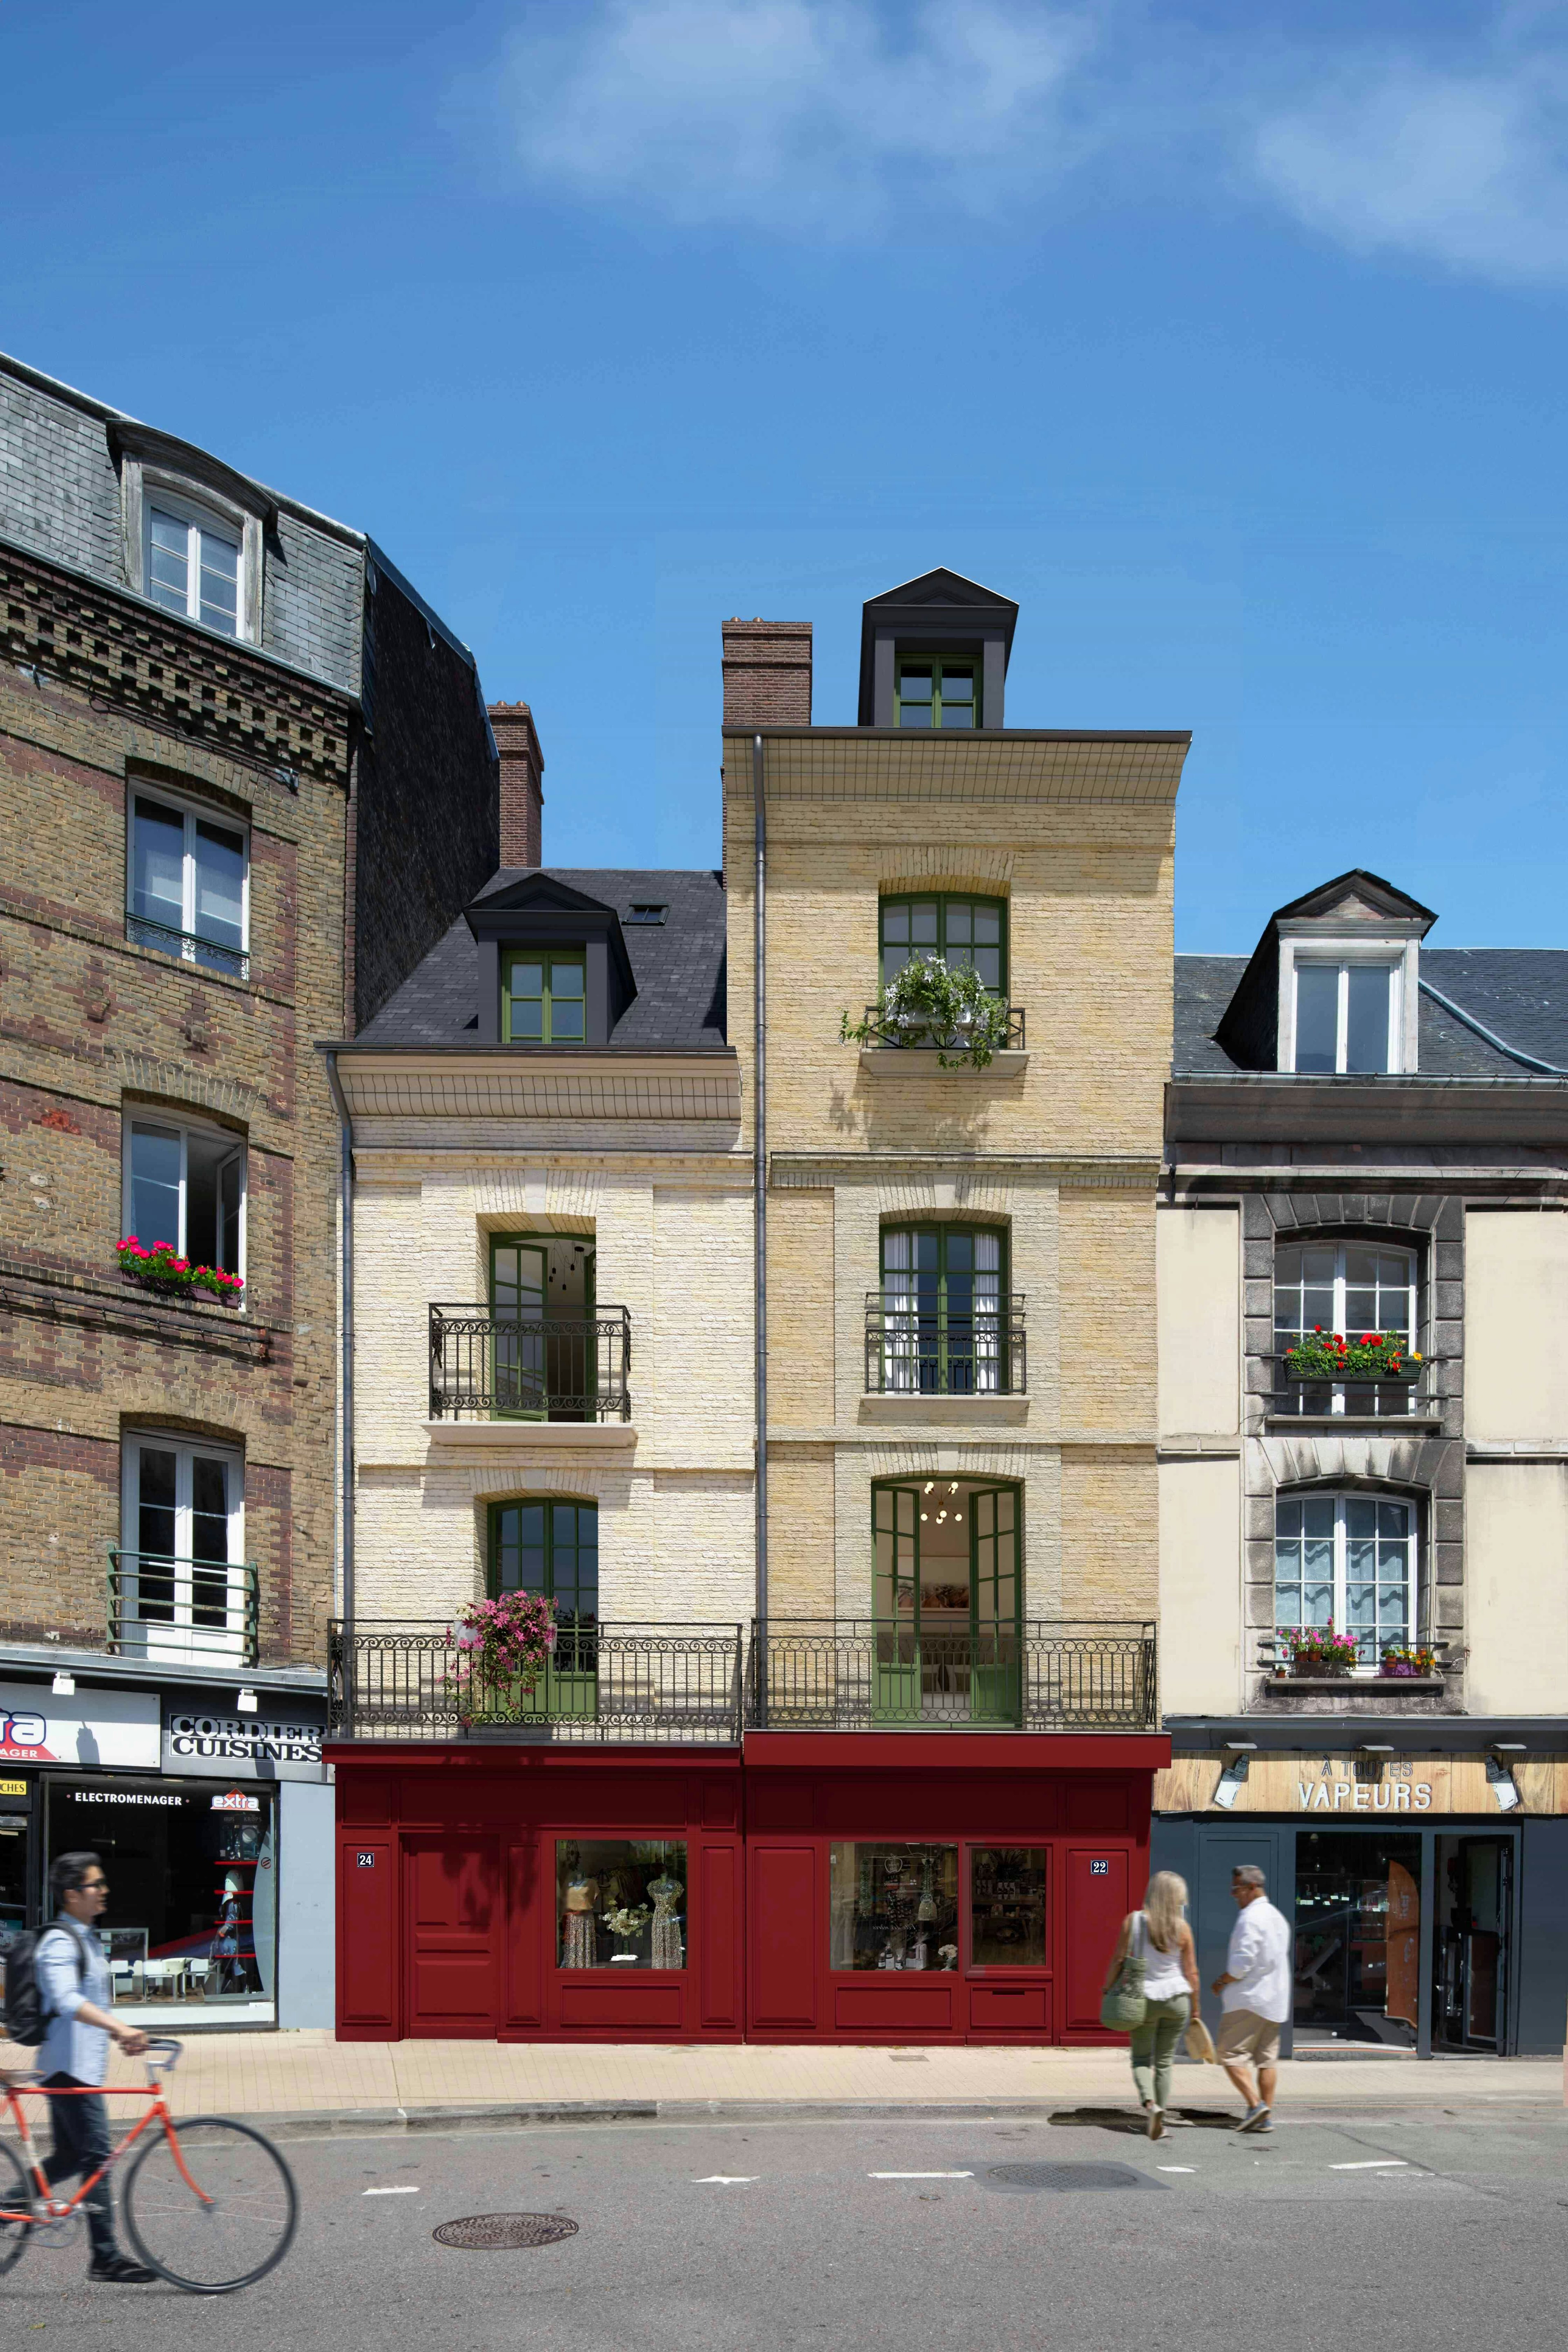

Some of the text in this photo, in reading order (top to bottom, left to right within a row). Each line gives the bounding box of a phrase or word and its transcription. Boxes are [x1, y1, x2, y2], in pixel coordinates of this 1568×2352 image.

[172, 1716, 320, 1744] CORDIER
[172, 1736, 322, 1762] CUISINES
[1321, 1755, 1413, 1777] À TOUTES
[0, 1783, 24, 1792] CHES
[75, 1792, 182, 1805] ELECTROMENAGER
[213, 1794, 258, 1809] extra
[1298, 1783, 1432, 1809] VAPEURS
[360, 1855, 372, 1865] 24
[1094, 1862, 1106, 1873] 22
